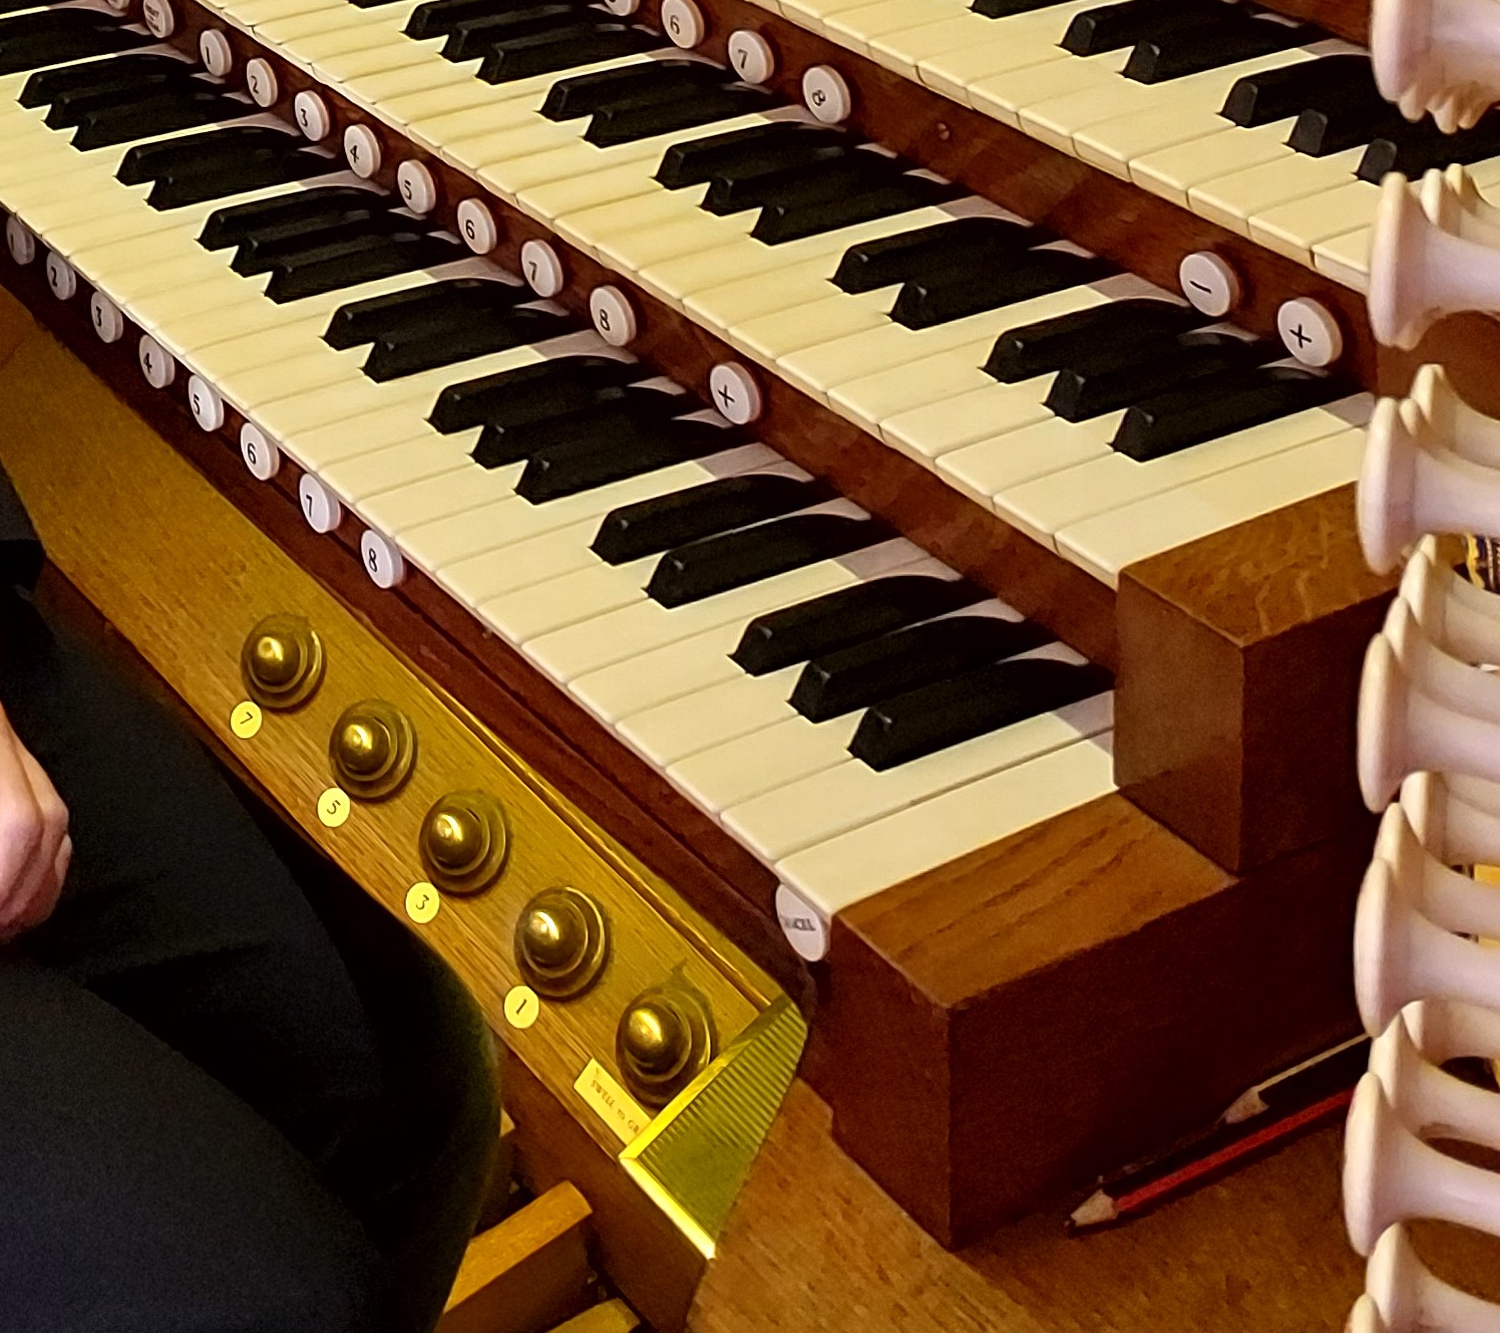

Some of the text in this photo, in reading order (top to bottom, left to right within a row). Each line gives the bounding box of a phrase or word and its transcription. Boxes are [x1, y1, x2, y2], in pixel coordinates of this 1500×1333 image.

[669, 14, 680, 35] 6
[205, 46, 212, 65] 1
[737, 49, 747, 70] 7
[250, 75, 259, 95] 2
[811, 89, 826, 107] 8
[300, 108, 309, 128] 3
[349, 145, 360, 164] 4
[404, 179, 413, 201] 5
[465, 219, 476, 240] 6
[50, 265, 58, 288] 2
[528, 261, 537, 282] 7
[95, 305, 102, 328] 3
[599, 308, 611, 332] 8
[143, 352, 153, 374] 4
[193, 393, 201, 416] 5
[247, 442, 257, 465] 6
[305, 494, 313, 518] 7
[368, 548, 378, 573] 8
[239, 711, 254, 726] 7
[326, 799, 342, 816] 5
[415, 893, 430, 910] 3
[515, 998, 528, 1015] 1
[590, 1079, 616, 1107] SWELL
